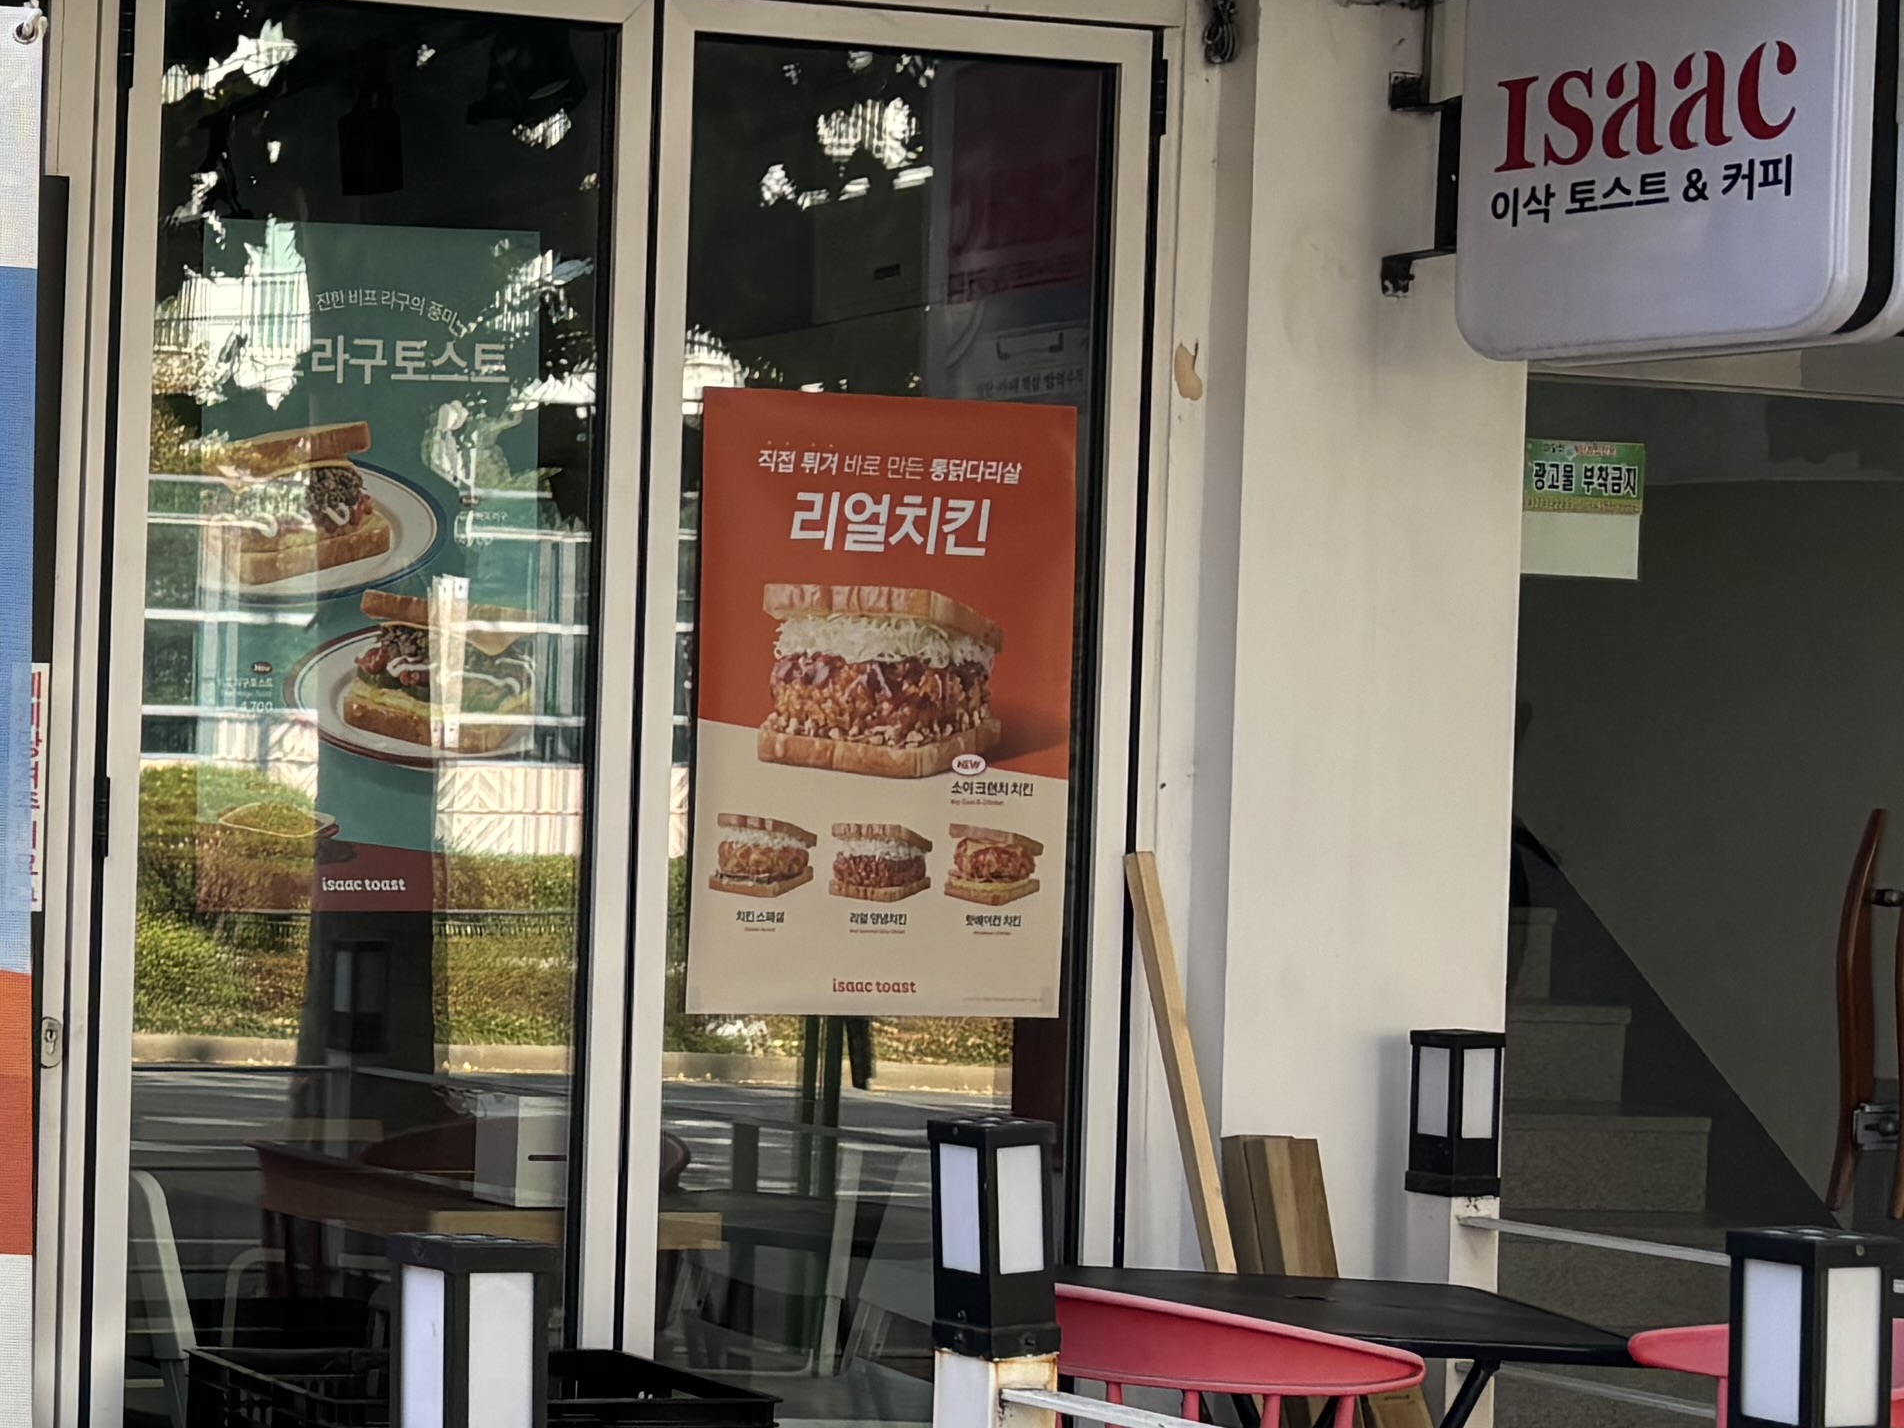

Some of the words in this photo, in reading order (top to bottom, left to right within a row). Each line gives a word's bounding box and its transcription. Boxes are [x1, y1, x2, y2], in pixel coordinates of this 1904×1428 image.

[1495, 40, 1797, 173] Isaac
[1491, 181, 1556, 228] 이삭
[1564, 171, 1670, 217] 토스트
[1683, 169, 1710, 203] &
[1721, 153, 1793, 202] 커피
[316, 290, 344, 312] 진한
[348, 288, 377, 307] 비프
[381, 291, 425, 317] 라구의
[311, 334, 510, 384] 라구토스트
[758, 449, 796, 473] 직접
[801, 451, 839, 475] 튀겨
[844, 454, 881, 476] 바로
[887, 456, 924, 480] 만든
[929, 458, 1023, 484] 통닭다리살
[1533, 461, 1574, 492] 광고물
[1583, 465, 1638, 497] 부착금지
[790, 491, 991, 556] 리얼치킨
[951, 781, 973, 795] 소이
[1010, 782, 1033, 796] 치킨
[321, 874, 363, 893] isaac
[368, 876, 406, 894] toast
[832, 978, 873, 993] isaac
[875, 979, 916, 994] toast
